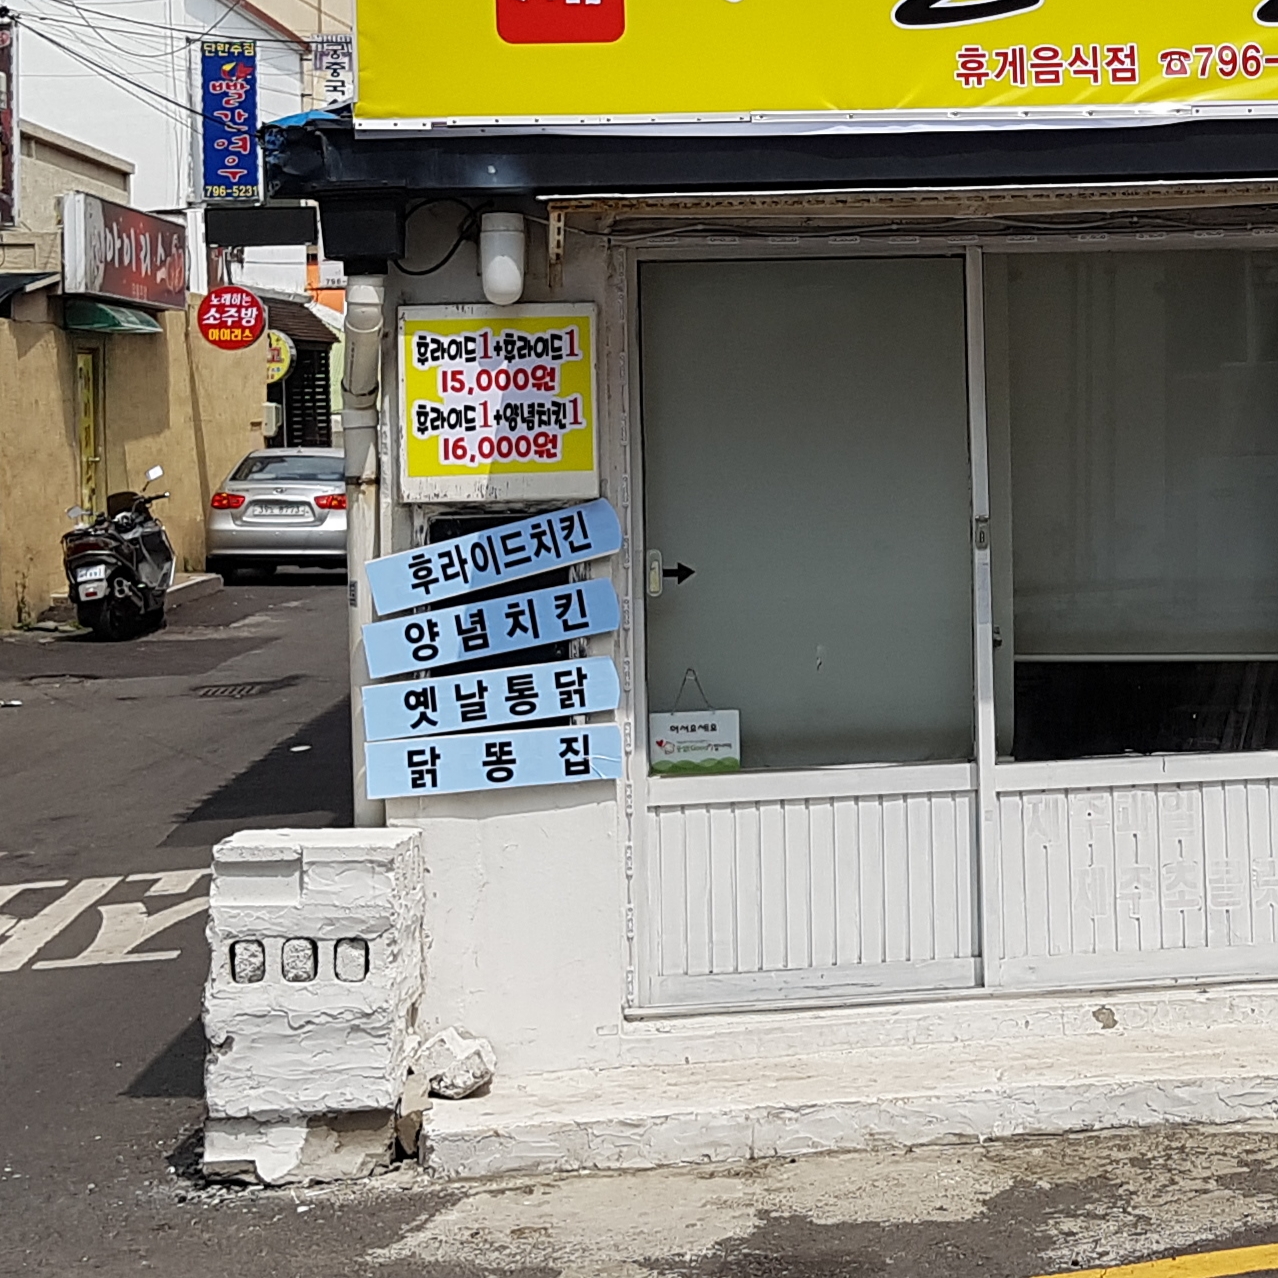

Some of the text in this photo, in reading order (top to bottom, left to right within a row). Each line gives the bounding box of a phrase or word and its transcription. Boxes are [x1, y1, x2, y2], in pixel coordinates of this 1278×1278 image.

[955, 44, 1138, 87] 휴게음식점
[205, 185, 258, 197] 796-5231
[210, 293, 251, 305] 노래하는
[202, 307, 258, 326] 소주방
[441, 365, 556, 395] 15,000원
[443, 431, 558, 463] 16,000원
[408, 510, 592, 595] 후라이드치킨
